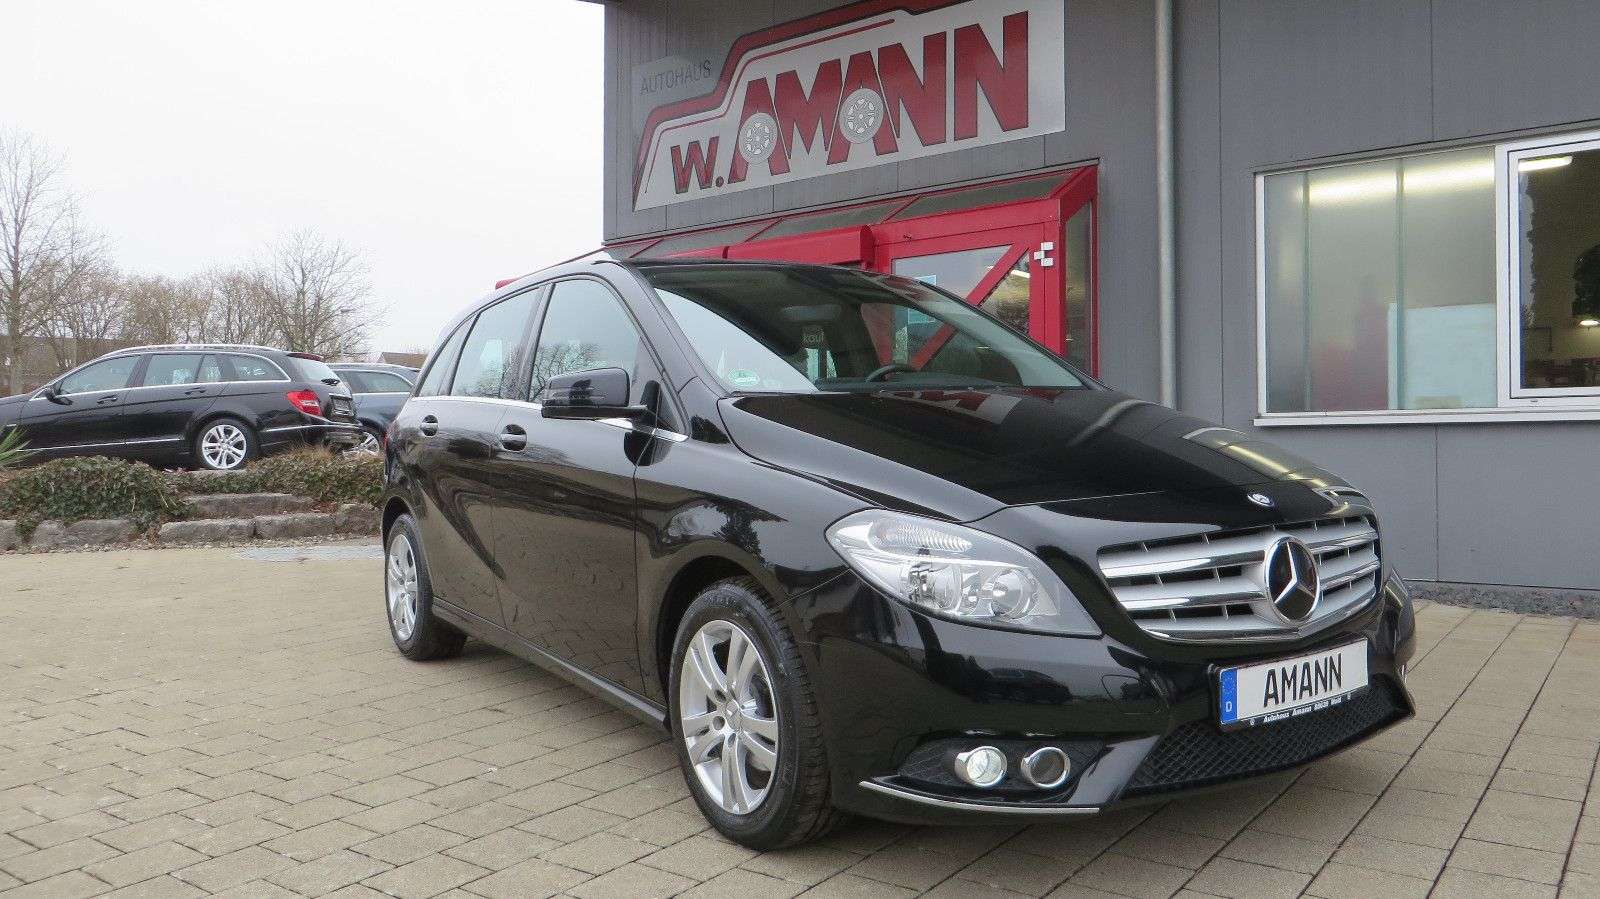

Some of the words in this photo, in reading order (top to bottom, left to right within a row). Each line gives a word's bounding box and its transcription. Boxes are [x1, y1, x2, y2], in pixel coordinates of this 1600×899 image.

[640, 59, 712, 95] AUTOHAUS
[1225, 701, 1233, 712] D
[1263, 652, 1342, 708] AMANN
